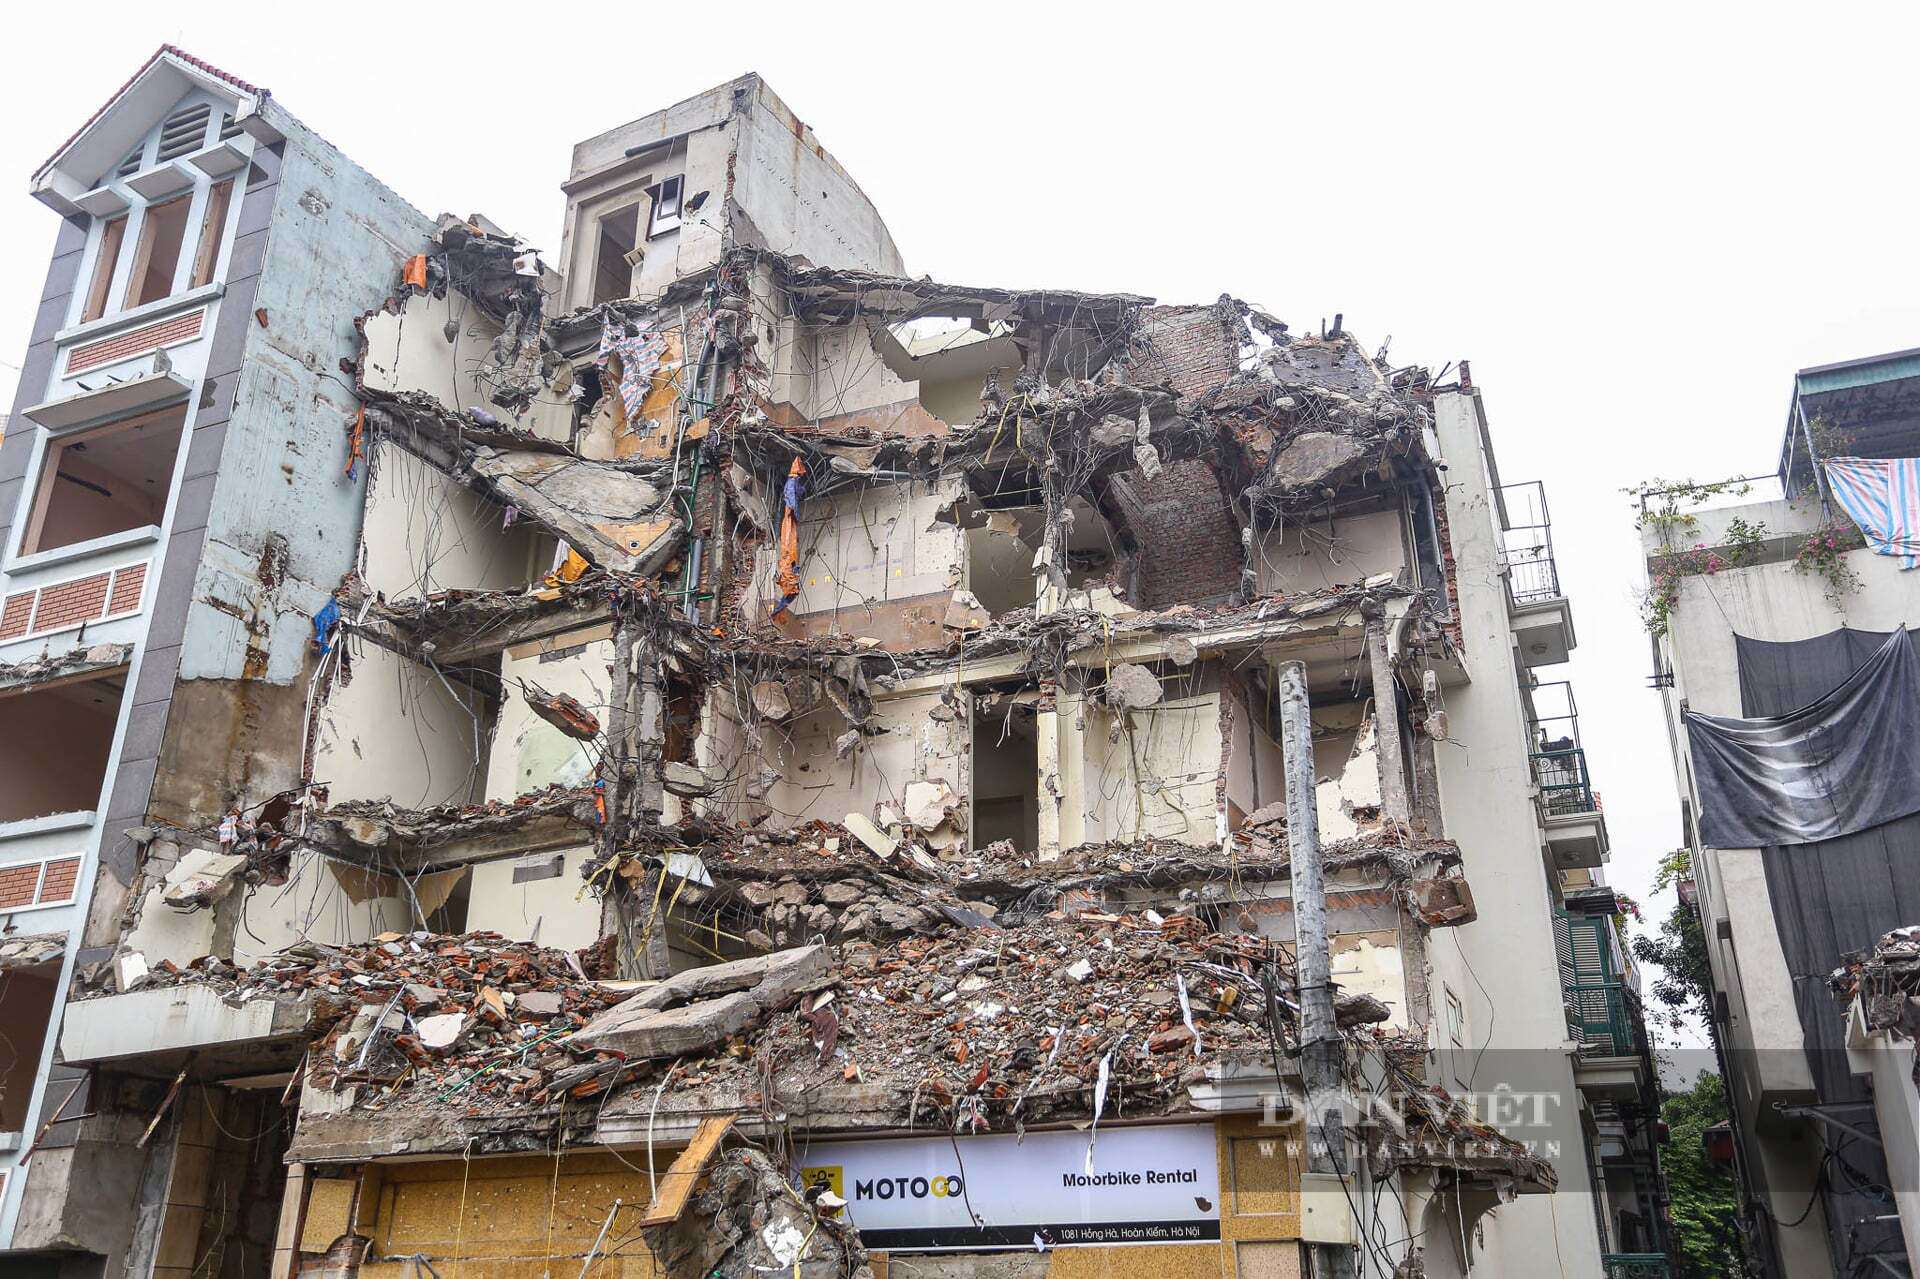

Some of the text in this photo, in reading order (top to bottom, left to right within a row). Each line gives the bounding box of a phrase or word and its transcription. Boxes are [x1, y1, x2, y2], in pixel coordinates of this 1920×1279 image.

[856, 1174, 963, 1200] MOTOGO
[1063, 1169, 1197, 1187] Motorbike Rental
[1061, 1229, 1078, 1239] 1081
[1171, 1226, 1184, 1236] Hà
[1186, 1225, 1200, 1237] Nội
